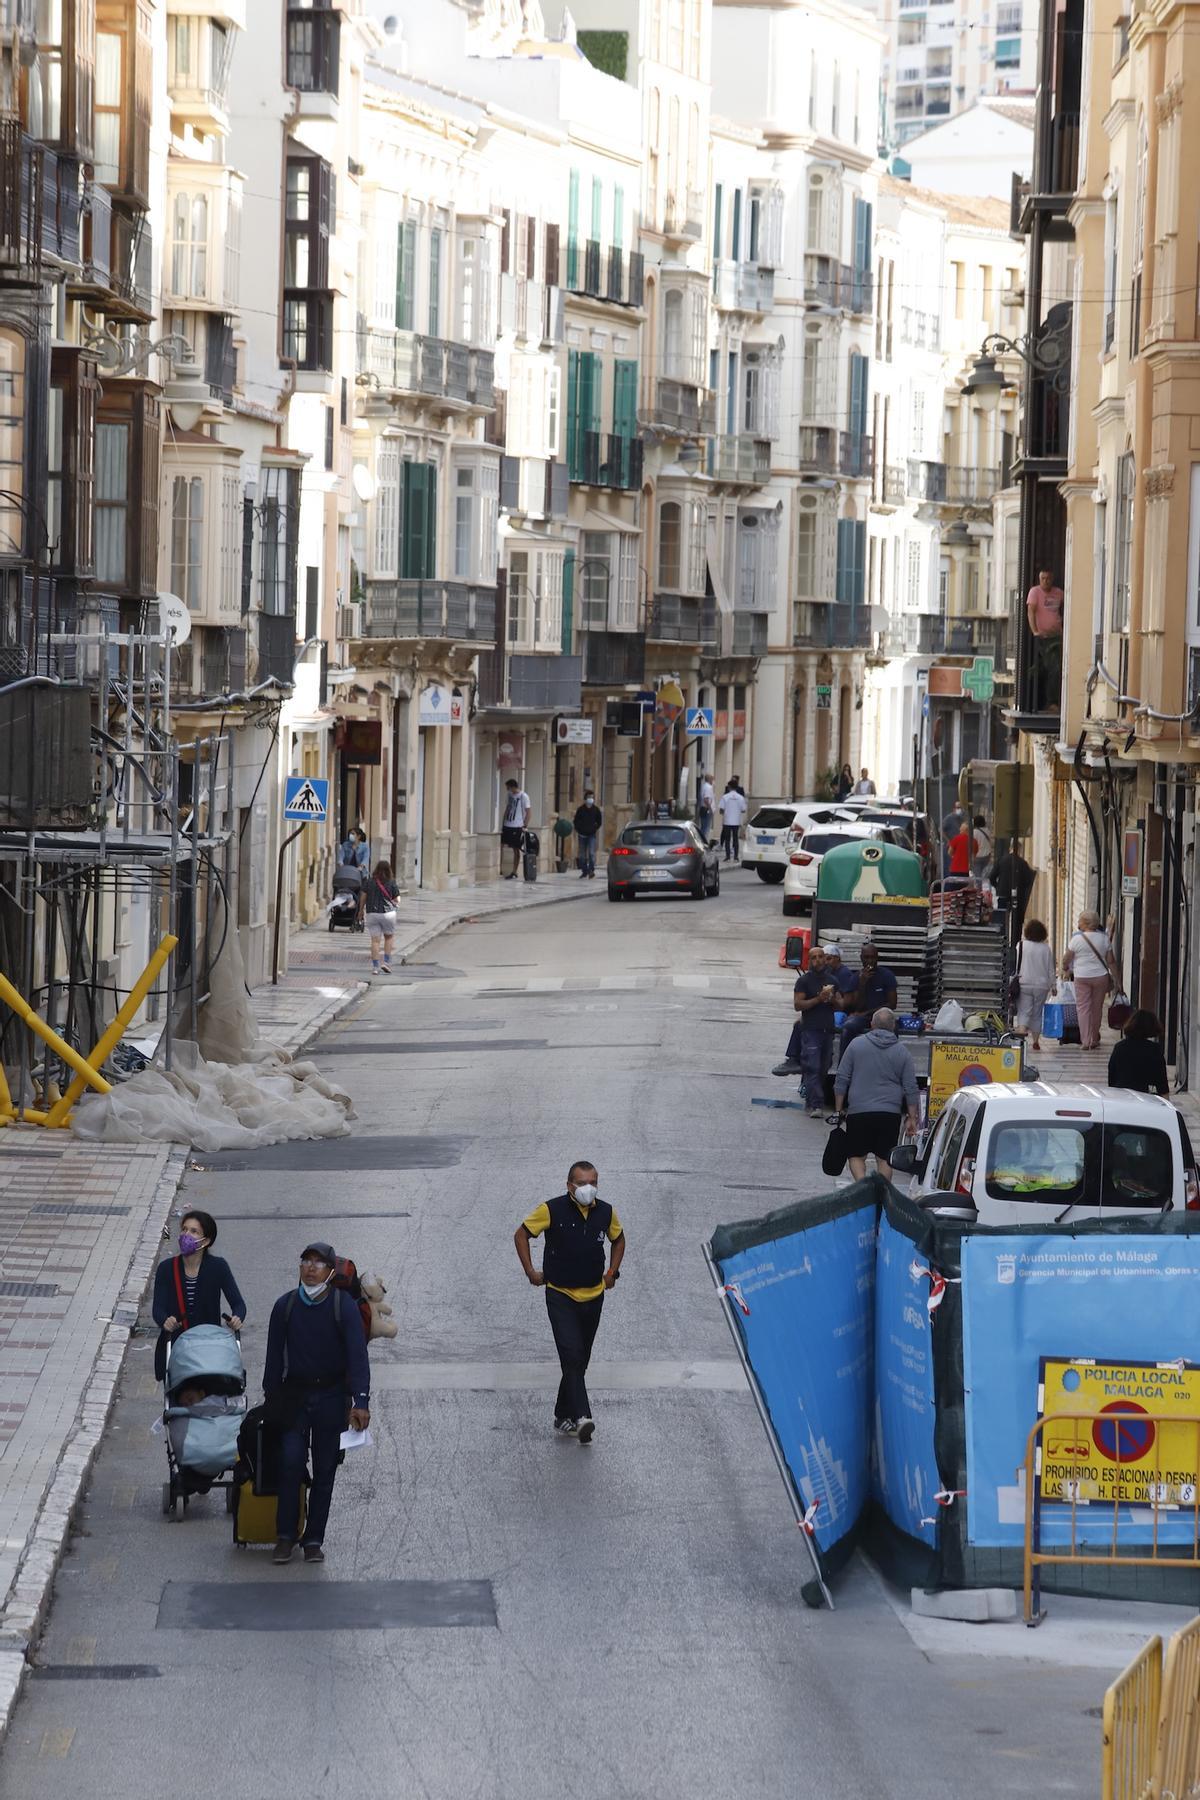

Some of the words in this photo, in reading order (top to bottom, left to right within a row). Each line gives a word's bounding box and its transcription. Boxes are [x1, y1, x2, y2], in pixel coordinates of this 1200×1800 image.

[935, 1045, 967, 1054] POLICIA
[970, 1047, 996, 1056] LOCAL
[945, 1053, 980, 1062] MALAGA
[1020, 1251, 1096, 1264] Ayuntamiento
[1099, 1251, 1113, 1263] de
[1116, 1250, 1158, 1264] Málaga
[1020, 1268, 1055, 1277] Gerencia
[1056, 1267, 1099, 1278] Municipal
[1101, 1267, 1112, 1276] de
[1165, 1265, 1192, 1275] Obras
[1084, 1368, 1137, 1383] POLICIA
[1142, 1371, 1186, 1385] LOCAL
[1104, 1384, 1164, 1399] MALAGA
[1174, 1392, 1191, 1400] 020
[1045, 1465, 1098, 1481] PROHIBIDO
[1166, 1471, 1197, 1486] DESDE
[1044, 1481, 1063, 1496] LAS
[1111, 1486, 1130, 1499] DEL
[1183, 1486, 1193, 1501] 8
